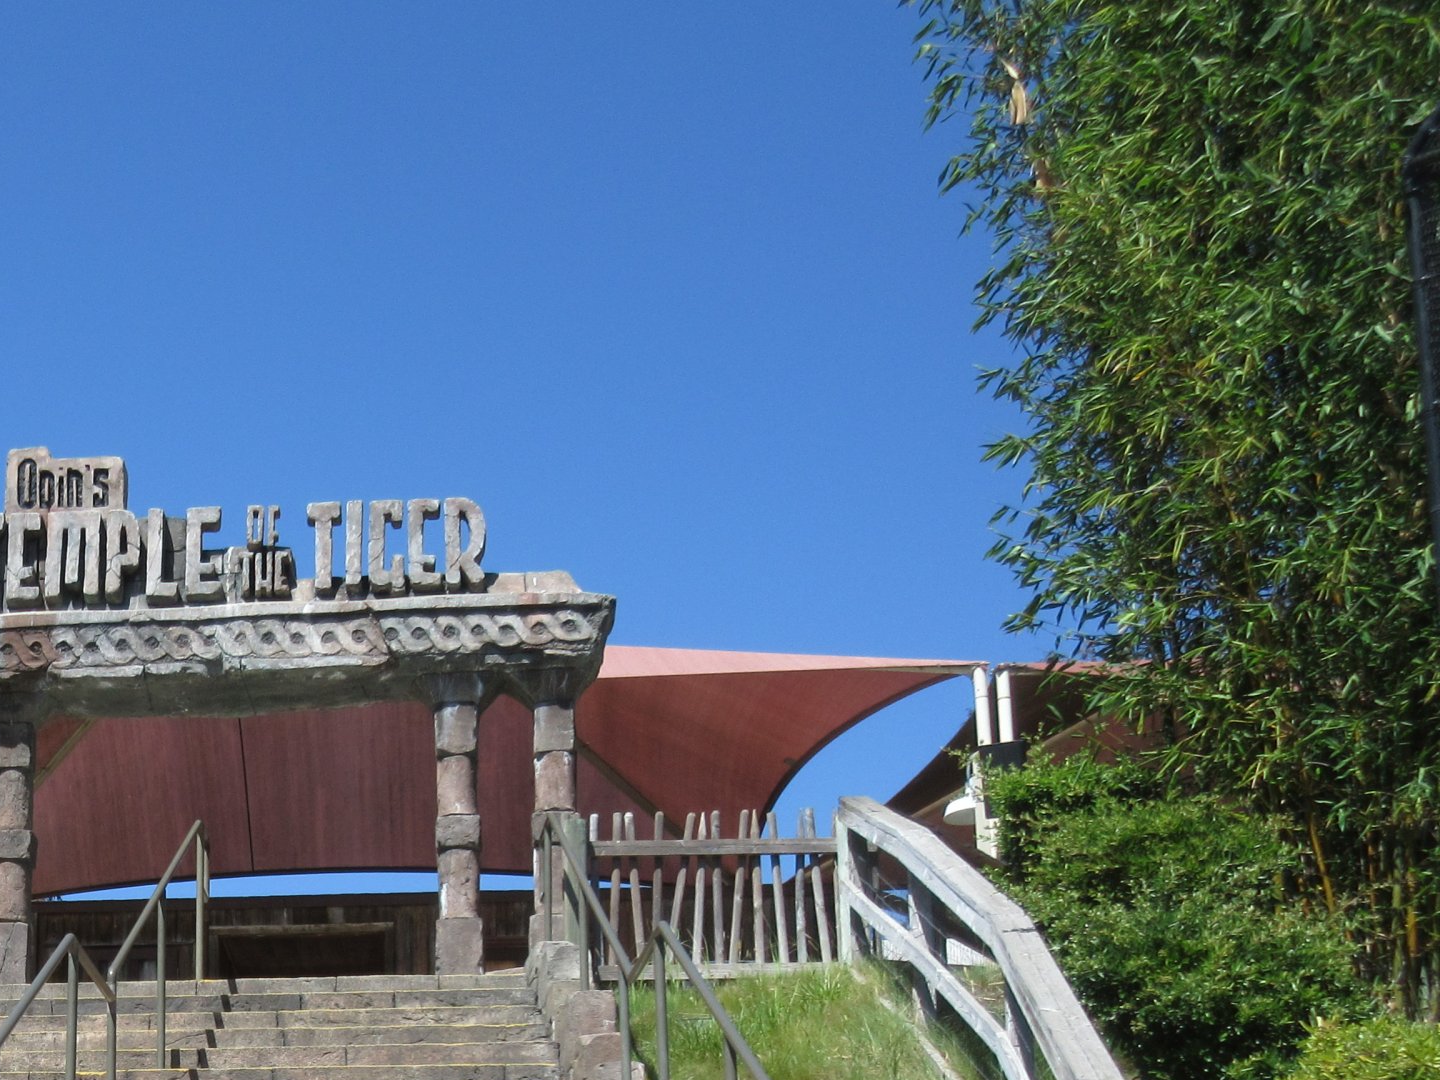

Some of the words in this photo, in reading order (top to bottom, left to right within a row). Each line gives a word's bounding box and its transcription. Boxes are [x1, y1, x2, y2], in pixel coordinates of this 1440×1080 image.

[246, 504, 281, 550] OF
[306, 497, 486, 594] TIGER
[239, 551, 292, 599] THE
